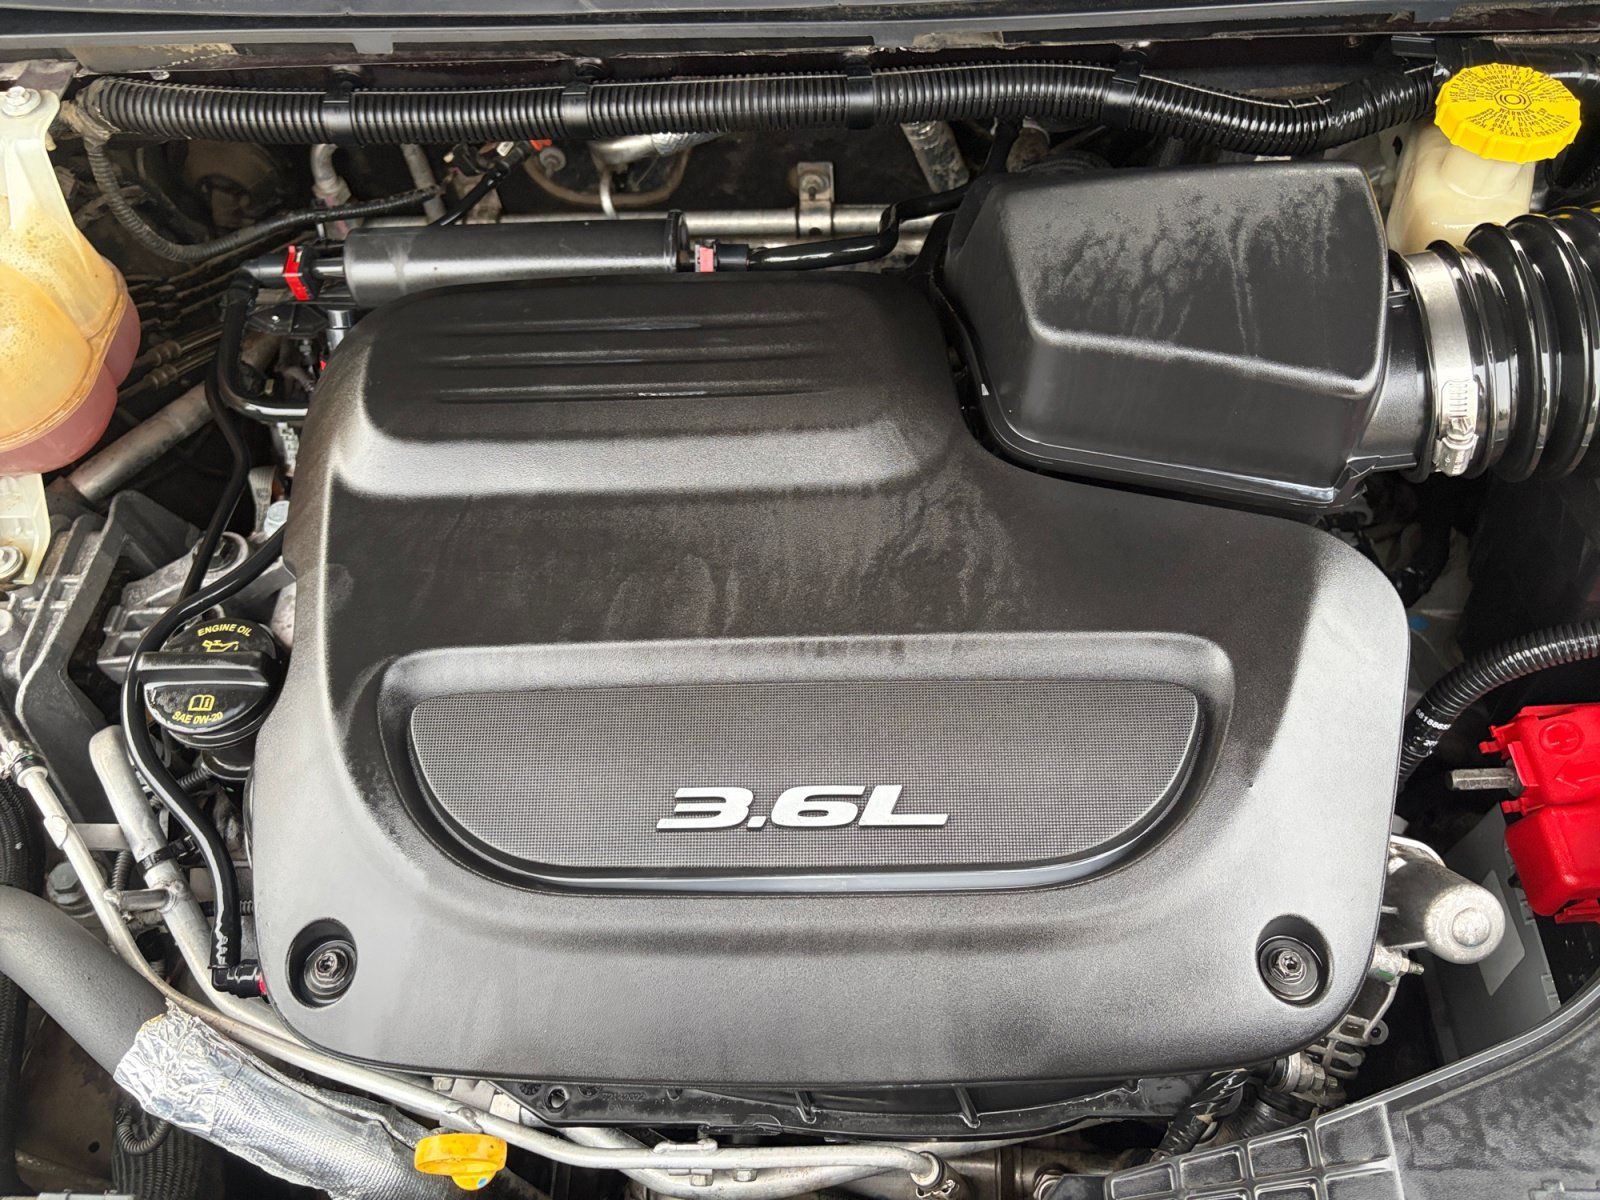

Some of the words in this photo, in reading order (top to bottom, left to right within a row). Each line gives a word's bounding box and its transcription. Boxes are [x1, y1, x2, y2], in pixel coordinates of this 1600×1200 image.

[1499, 107, 1535, 116] WARNING
[1499, 129, 1532, 138] SEALED
[197, 623, 236, 637] ENGINE
[236, 623, 253, 637] OIL
[171, 711, 192, 724] SAE
[193, 711, 224, 725] 0W-20
[656, 784, 949, 830] 3.6L
